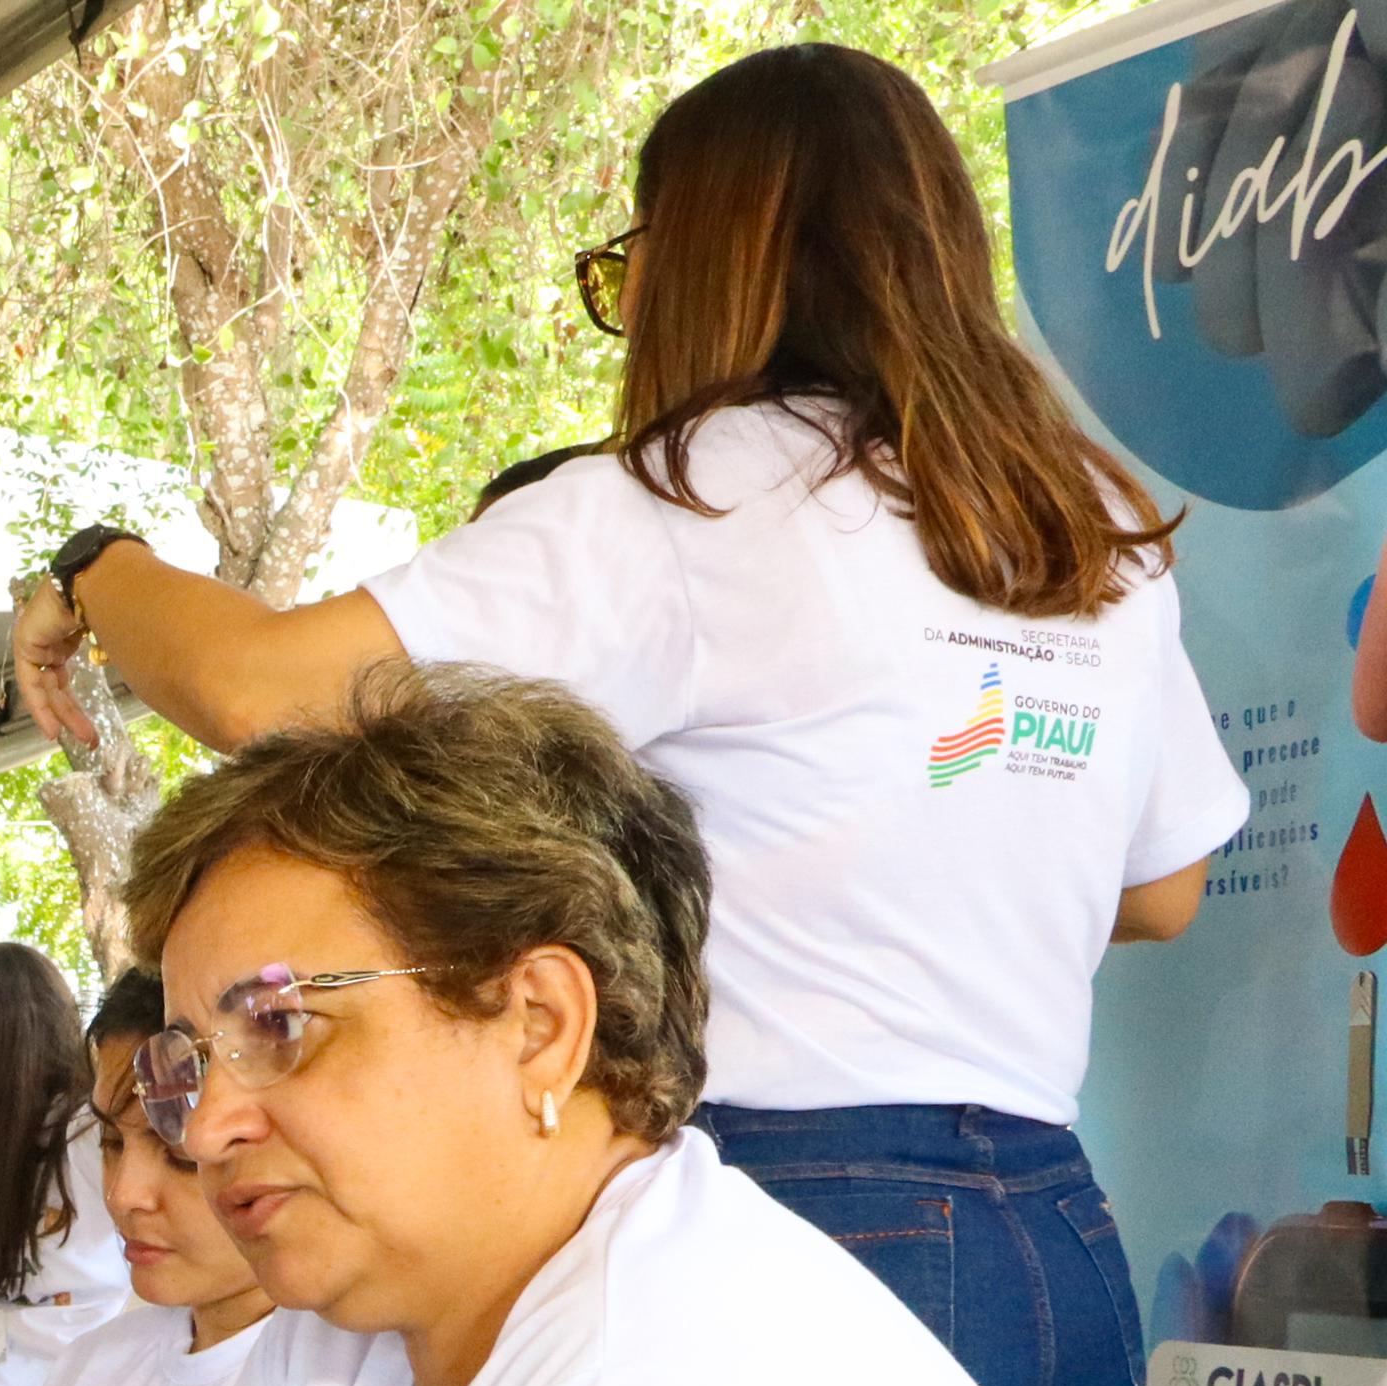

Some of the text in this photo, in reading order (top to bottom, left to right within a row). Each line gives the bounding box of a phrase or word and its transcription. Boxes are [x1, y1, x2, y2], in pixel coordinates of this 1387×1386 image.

[1106, 9, 1387, 340] diab
[924, 627, 945, 642] DA
[948, 631, 1054, 662] ADMINISTRAÇÃO
[1066, 651, 1101, 667] SEAD
[1021, 629, 1101, 650] SECRETARIA
[1014, 695, 1101, 719] GOVERNO DO
[1244, 704, 1277, 730] que
[1288, 700, 1295, 718] o
[1011, 711, 1097, 756] PIAUÍ
[1007, 750, 1087, 770] AQUI TEM TRABALHO
[1243, 737, 1320, 773] precoce
[1004, 763, 1075, 781] AQUI TEM FUTURO
[1211, 822, 1318, 858] plicações
